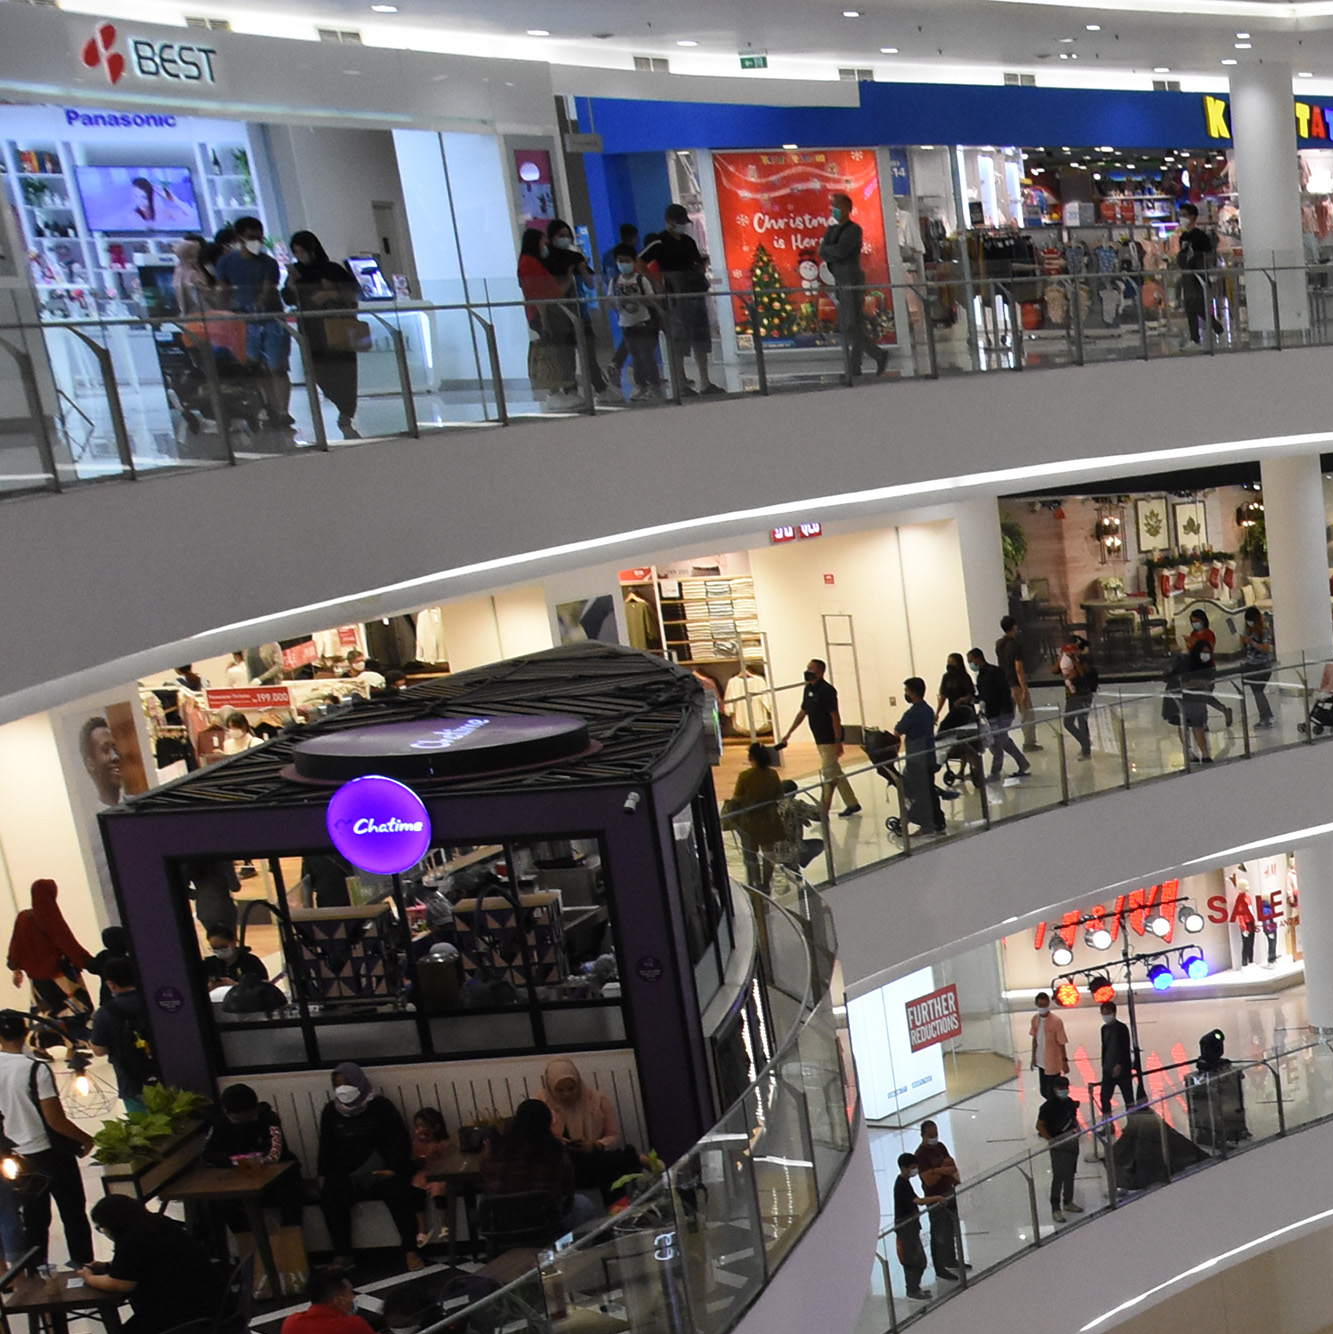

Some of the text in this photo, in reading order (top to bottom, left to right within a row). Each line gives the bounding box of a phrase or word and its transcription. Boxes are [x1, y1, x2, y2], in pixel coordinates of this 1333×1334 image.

[131, 39, 217, 83] BEST
[65, 108, 177, 128] Panasonic
[791, 233, 824, 250] Her
[353, 817, 424, 834] Chatime
[1207, 890, 1284, 924] SALE
[907, 992, 957, 1029] FURTHER
[910, 1013, 960, 1046] REDUCTIONS
